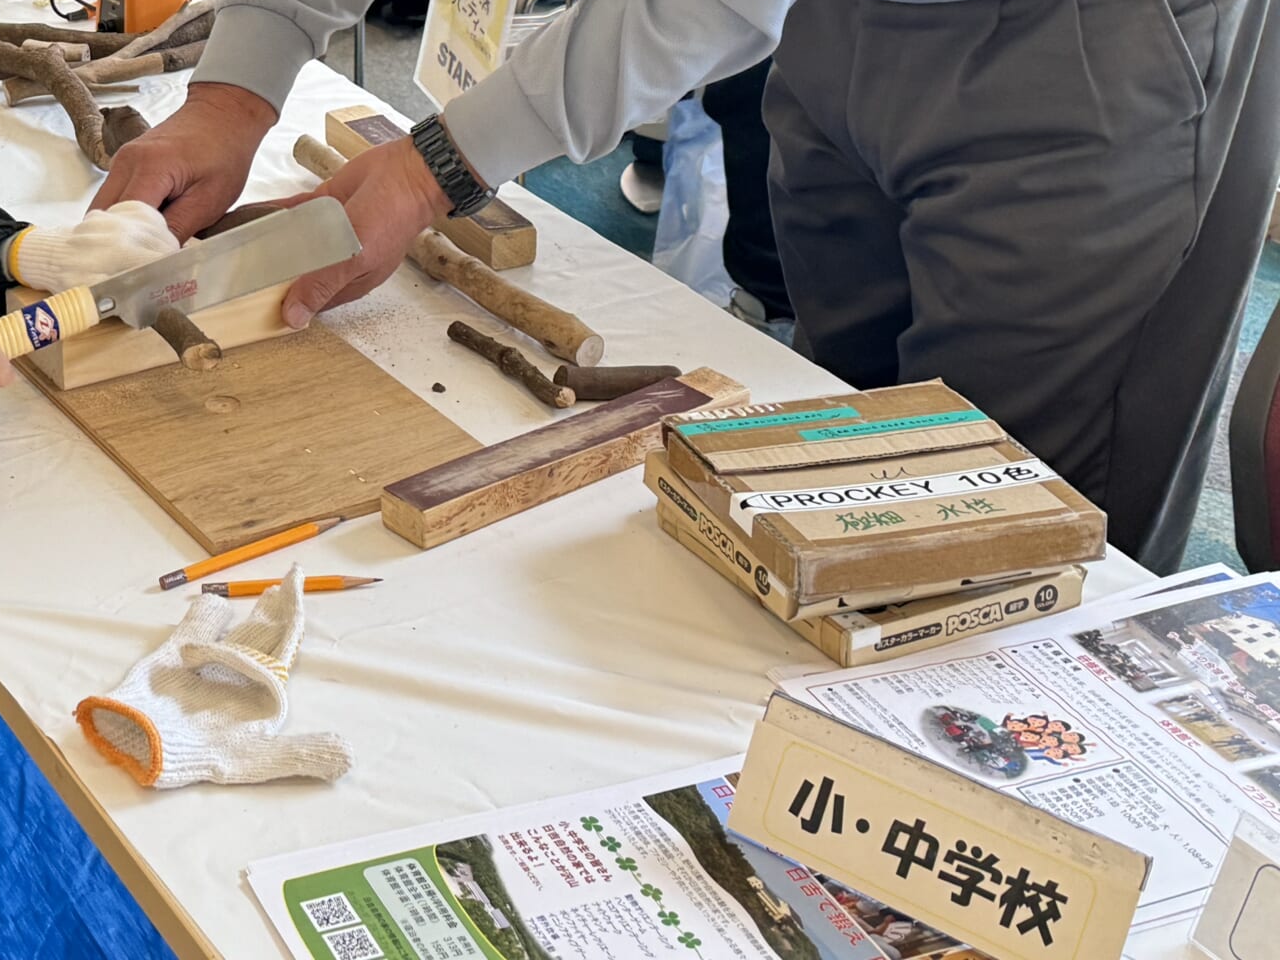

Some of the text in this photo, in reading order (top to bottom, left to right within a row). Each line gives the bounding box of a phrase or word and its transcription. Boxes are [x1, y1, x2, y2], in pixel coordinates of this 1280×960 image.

[770, 465, 1040, 510] PROCKEY 10色
[698, 511, 737, 564] POSCA
[945, 601, 1005, 637] POSCA
[1038, 587, 1056, 603] 10
[526, 828, 580, 887] こんなことが沢山
[541, 825, 596, 882] 日吉自然の家では
[788, 776, 1069, 947] 小・中学校
